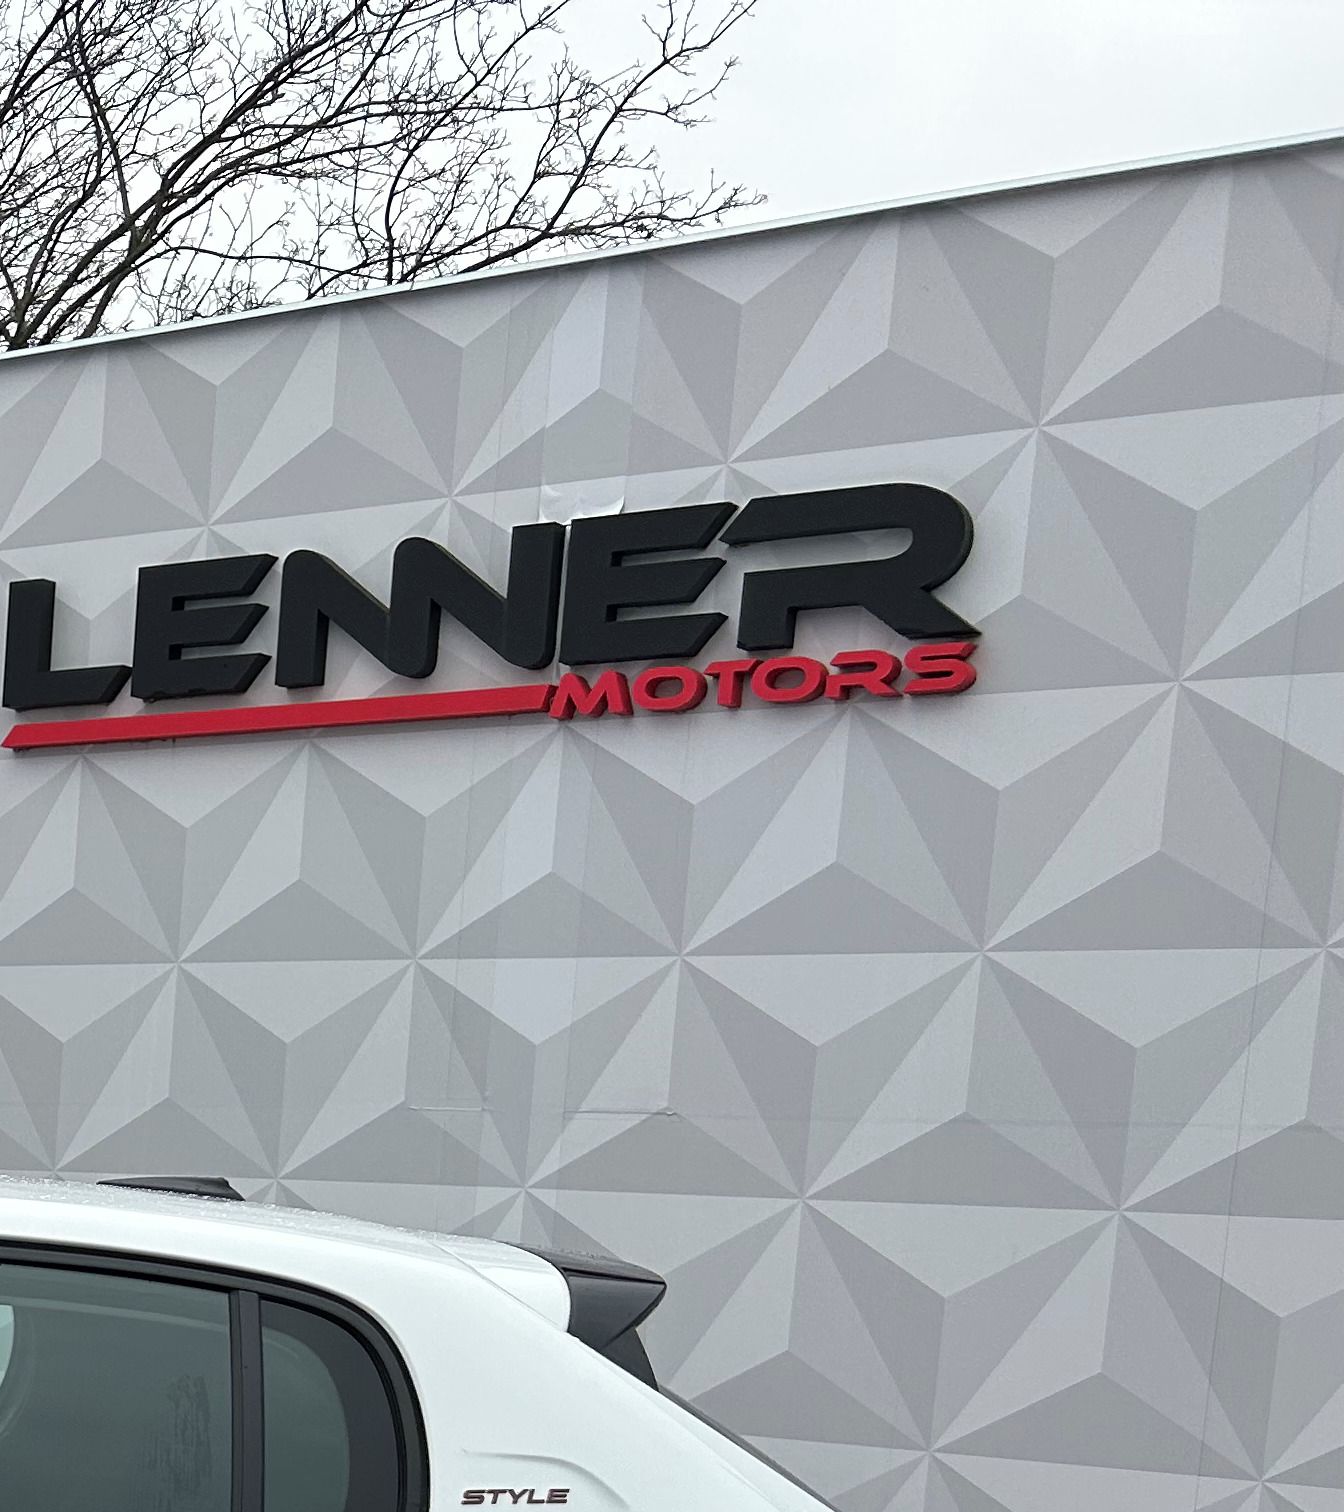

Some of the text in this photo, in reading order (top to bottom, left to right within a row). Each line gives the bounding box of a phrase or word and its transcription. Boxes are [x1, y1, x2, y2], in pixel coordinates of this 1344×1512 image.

[2, 482, 983, 714] LENNER
[549, 641, 978, 720] MOTORS
[461, 1488, 570, 1505] STYLE
